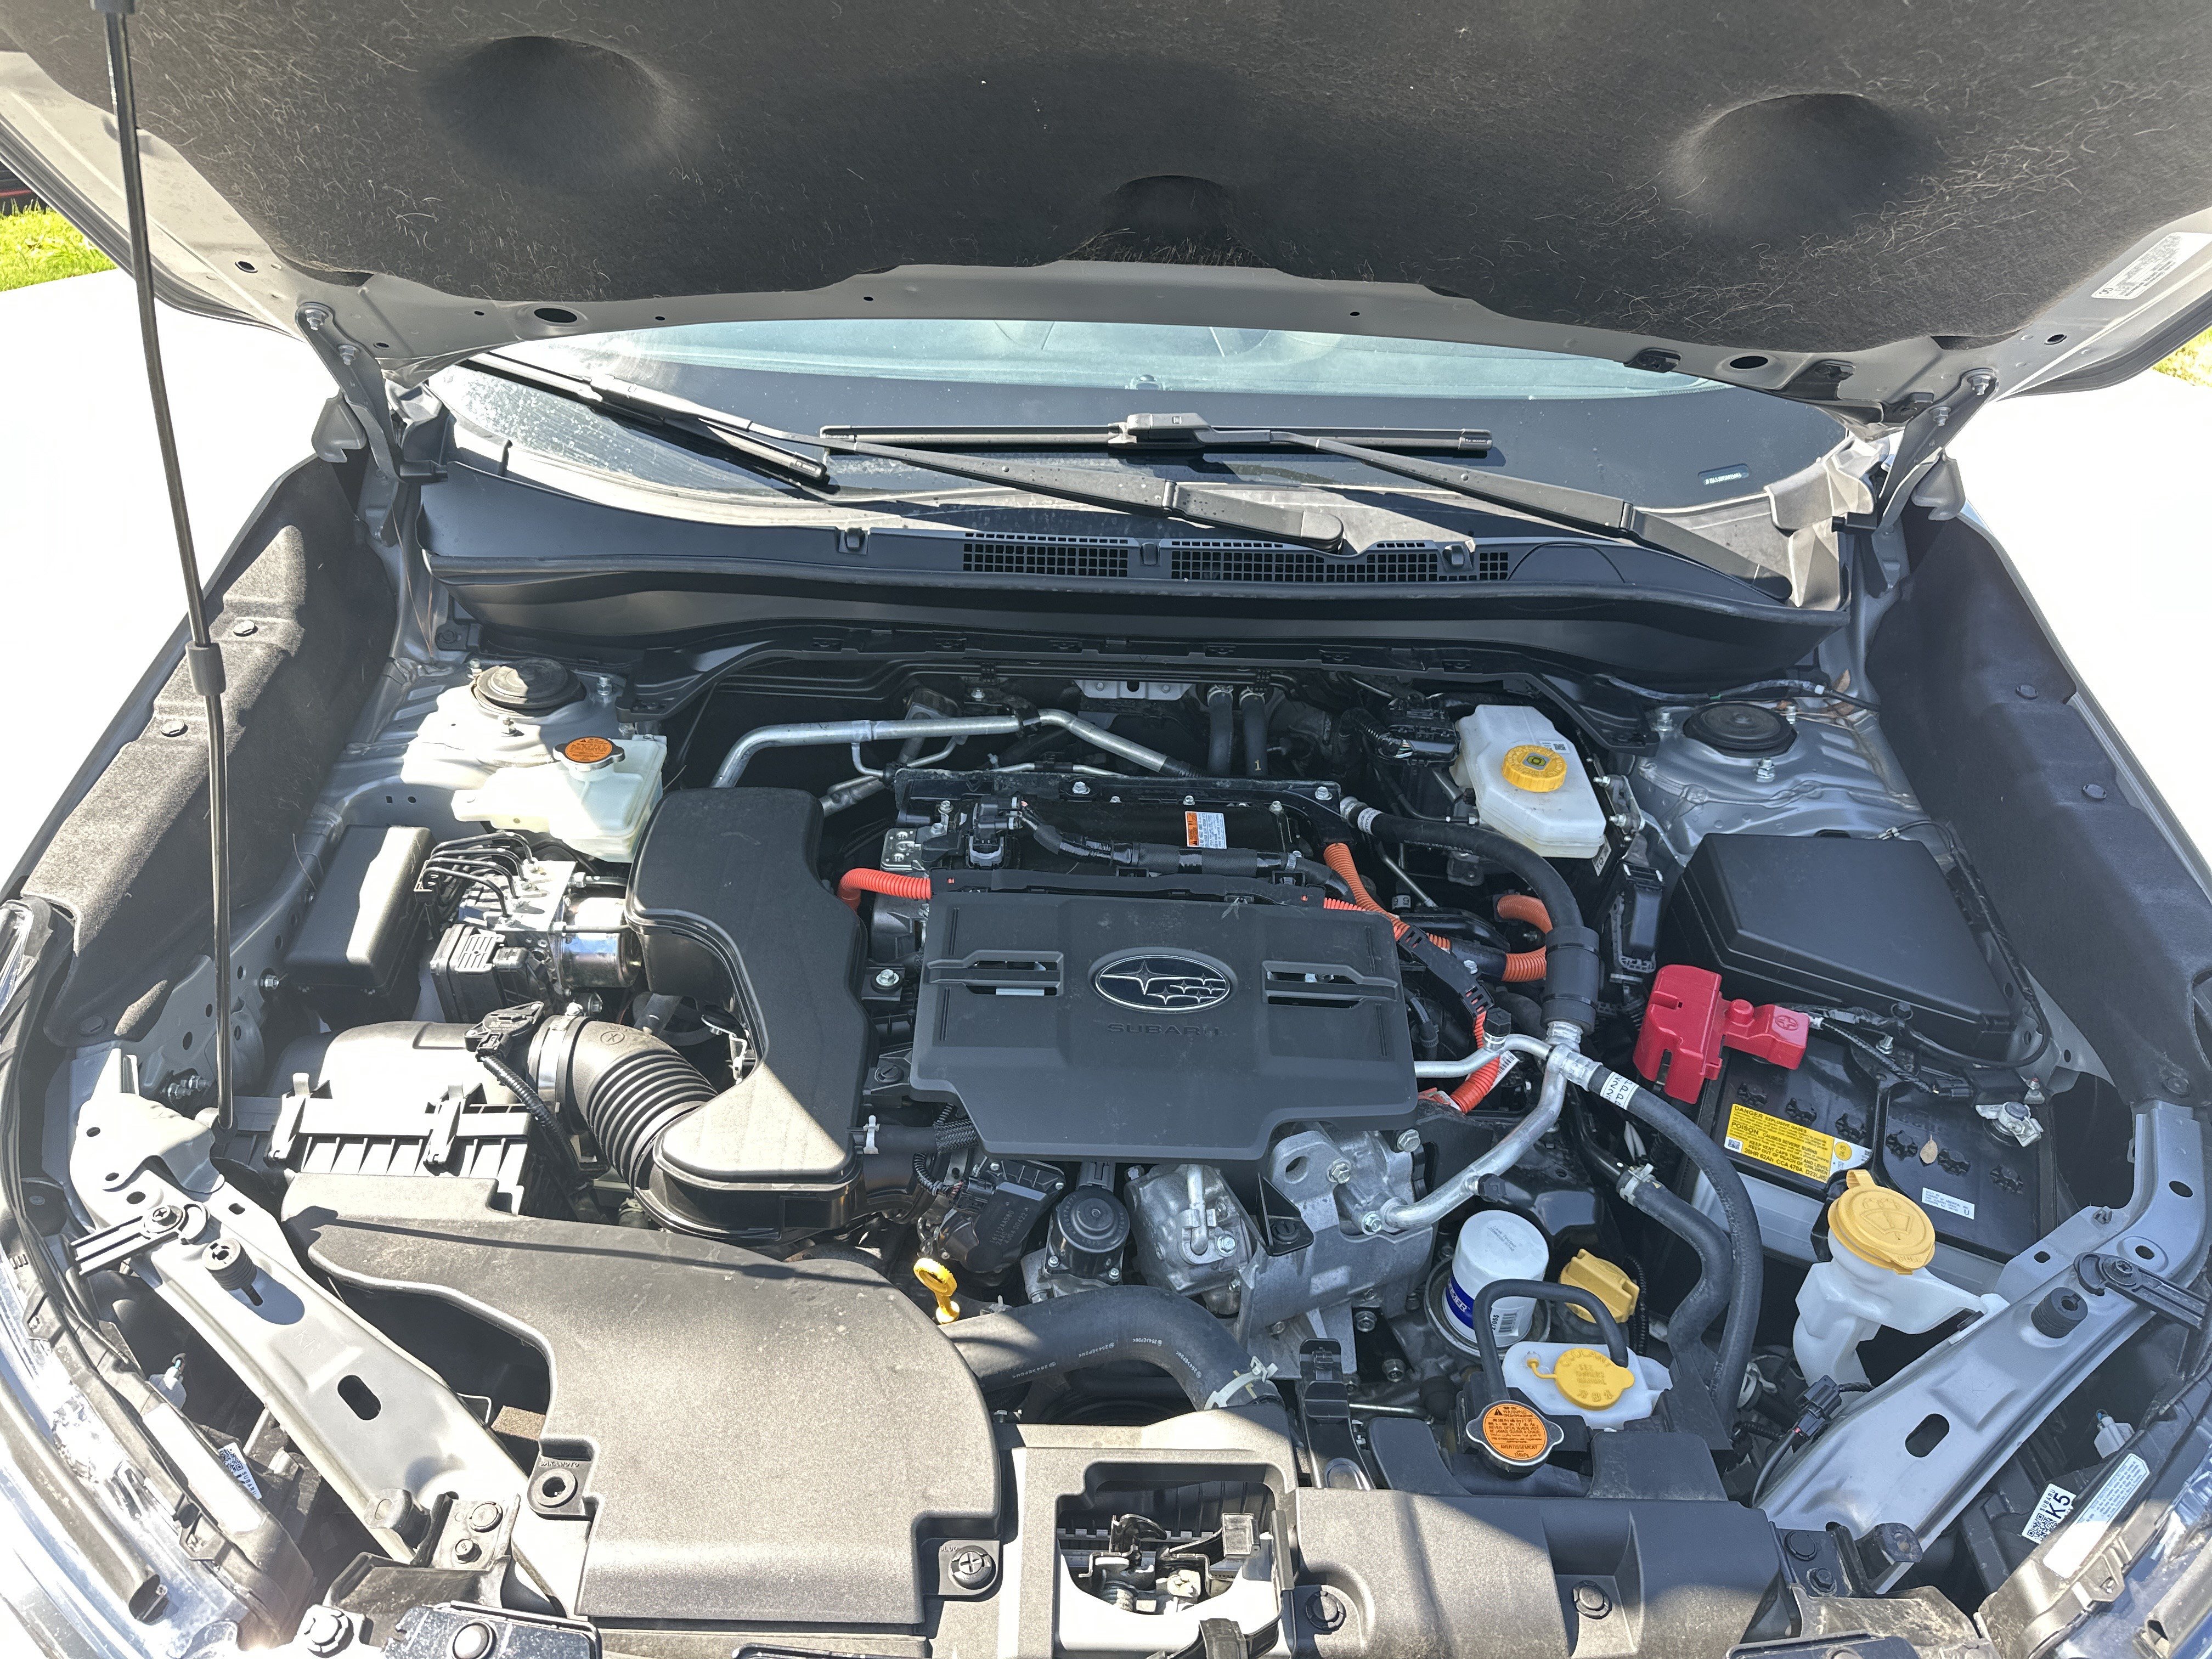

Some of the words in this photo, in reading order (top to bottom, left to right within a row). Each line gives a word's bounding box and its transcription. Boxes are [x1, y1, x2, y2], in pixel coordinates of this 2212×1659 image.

[1734, 1105, 1763, 1119] DANGER
[1791, 1125, 1807, 1133] GASES
[1731, 1121, 1759, 1135] POISON
[1762, 1132, 1781, 1142] CAUSES
[1781, 1139, 1801, 1149] SEVERE
[1801, 1146, 1818, 1155] BURNS
[1744, 1147, 1759, 1157] 20HR
[1759, 1153, 1774, 1162] 62Ah
[1775, 1159, 1790, 1168] CCA
[1788, 1163, 1803, 1173] 470A
[1748, 1143, 1760, 1152] KEEP
[1779, 1154, 1796, 1164] REACH
[1804, 1163, 1827, 1175] CHILDREN
[1775, 1148, 1788, 1156] CAPS
[1789, 1153, 1802, 1161] TIGHT
[1814, 1162, 1829, 1171] LEVEL
[2039, 1489, 2056, 1511] SUBARU
[2045, 1492, 2072, 1520] K5
